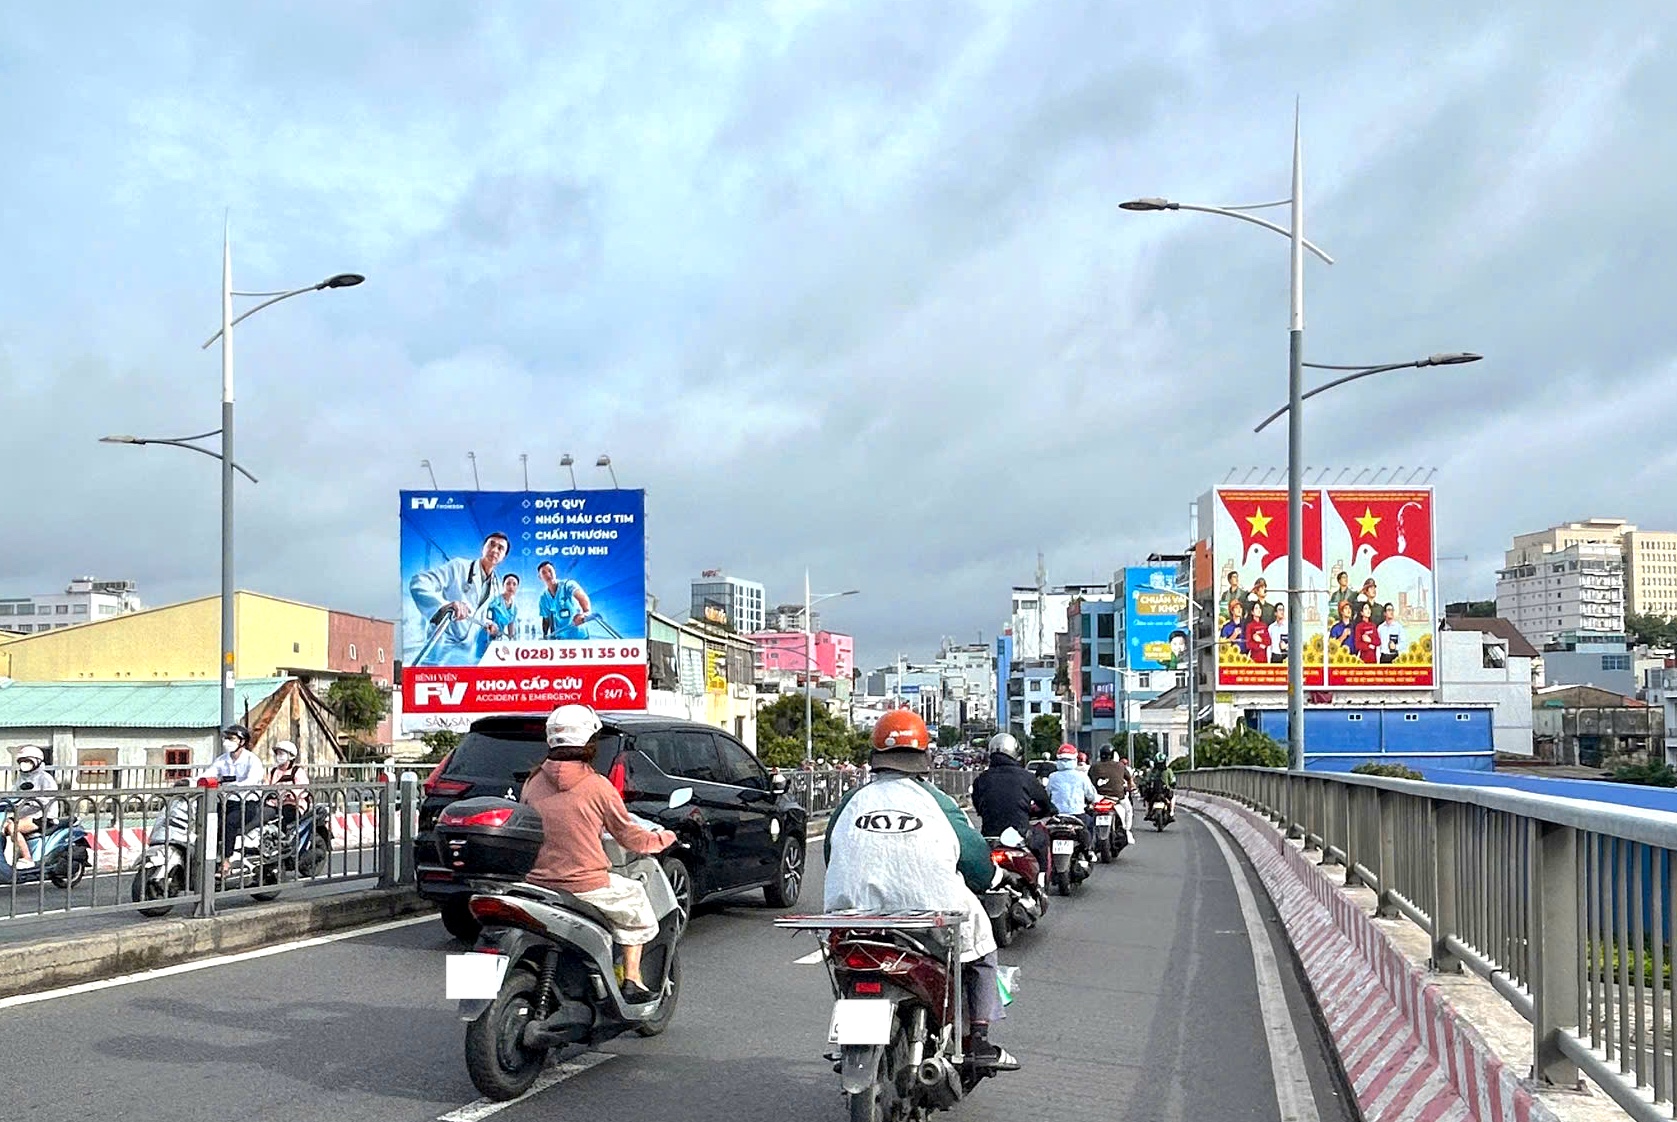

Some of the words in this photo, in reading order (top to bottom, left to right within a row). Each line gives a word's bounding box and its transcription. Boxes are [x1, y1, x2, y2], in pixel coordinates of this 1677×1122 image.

[411, 497, 438, 509] FV
[535, 497, 559, 510] ĐỘT
[535, 513, 564, 524] NHỐI
[566, 513, 592, 524] MÁU
[595, 514, 611, 524] CƠ
[613, 514, 634, 523] TIM
[535, 528, 567, 540] CHẤN
[570, 529, 618, 540] THƯƠNG
[535, 544, 559, 556] CẤP
[561, 544, 585, 556] CỨU
[588, 546, 608, 555] NHI
[515, 647, 554, 661] (028)
[559, 647, 577, 659] 35
[582, 647, 593, 659] 11
[598, 647, 616, 659] 35
[620, 647, 640, 658] 00
[475, 679, 517, 691] KHOA
[520, 675, 550, 690] CẤP
[552, 676, 583, 690] CỨU
[415, 682, 469, 705] FV
[475, 693, 521, 702] ACCIDENT
[522, 693, 528, 701] &
[528, 692, 582, 702] EMERGENCY
[604, 689, 623, 699] 24/7
